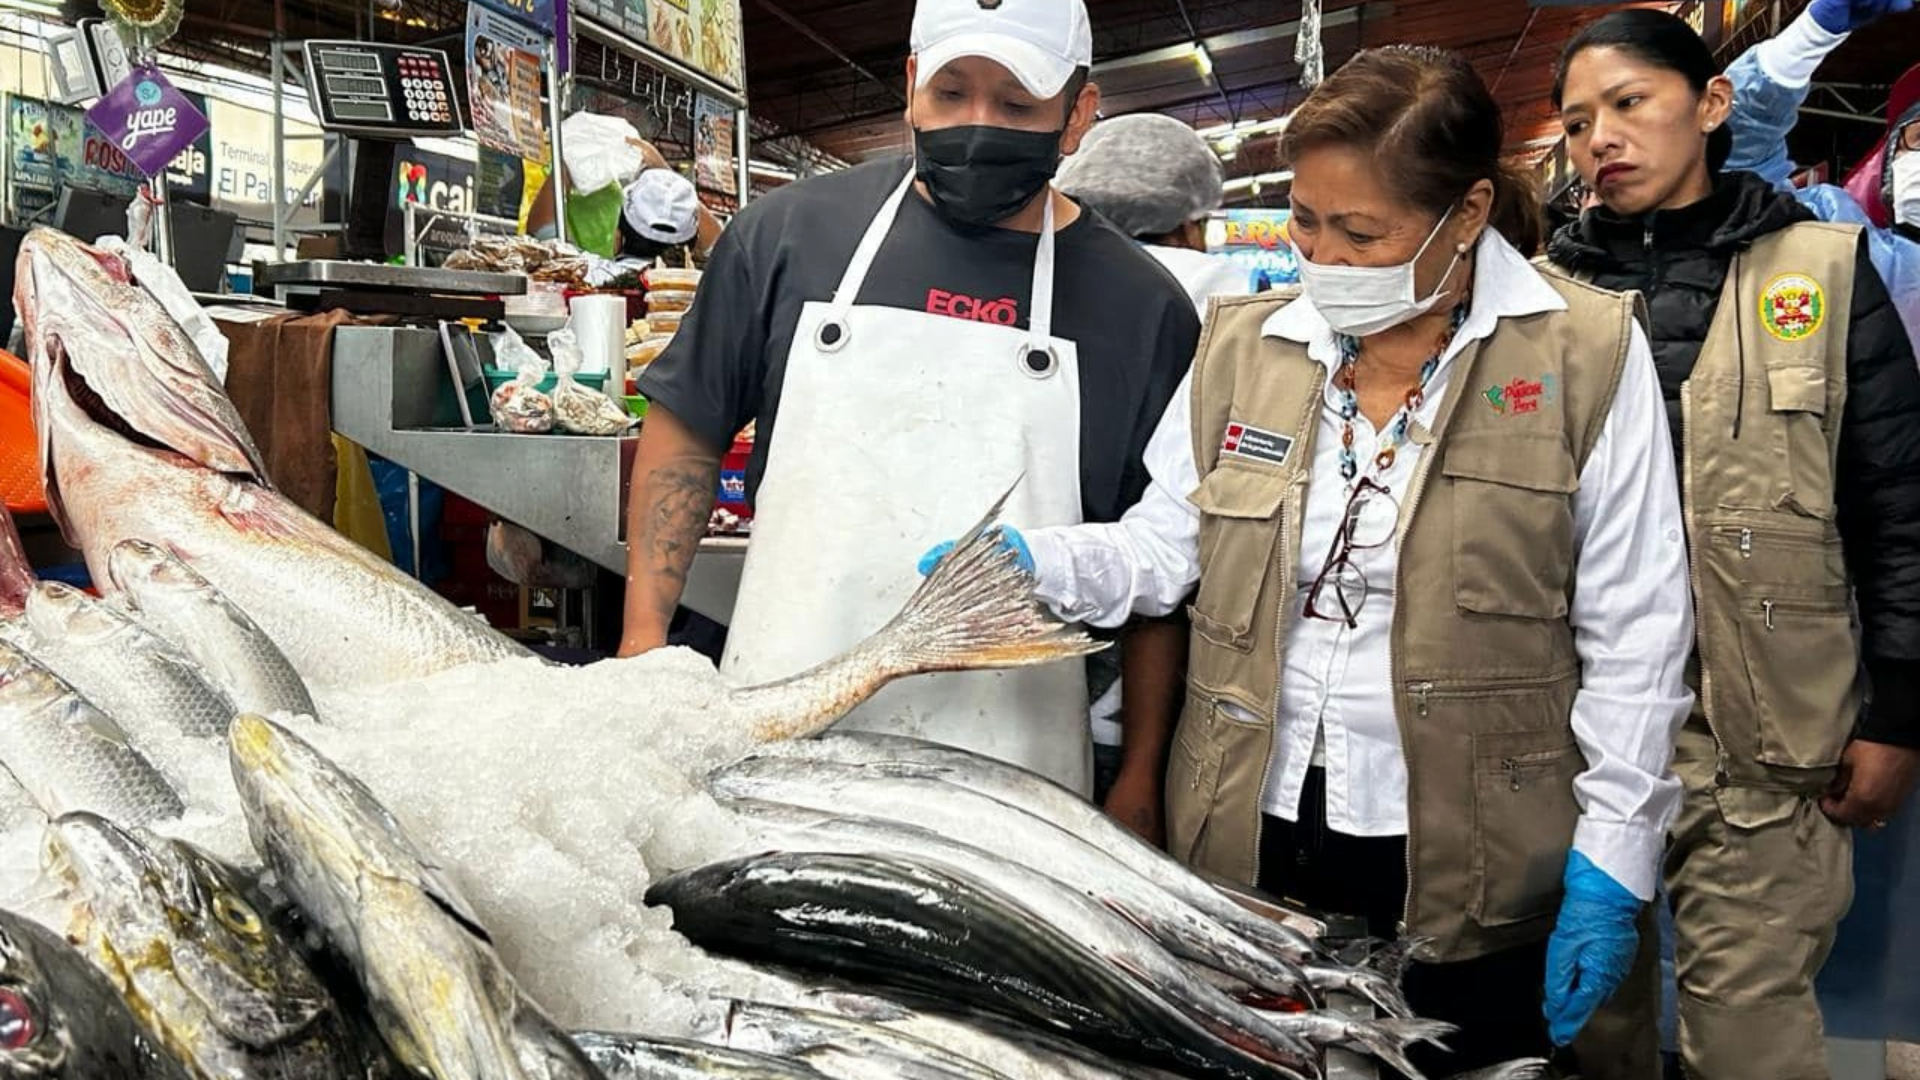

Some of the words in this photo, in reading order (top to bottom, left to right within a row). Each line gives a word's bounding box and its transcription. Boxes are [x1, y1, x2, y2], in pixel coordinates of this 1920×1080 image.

[122, 107, 177, 150] yape
[219, 167, 238, 195] El
[244, 172, 318, 209] Palmar
